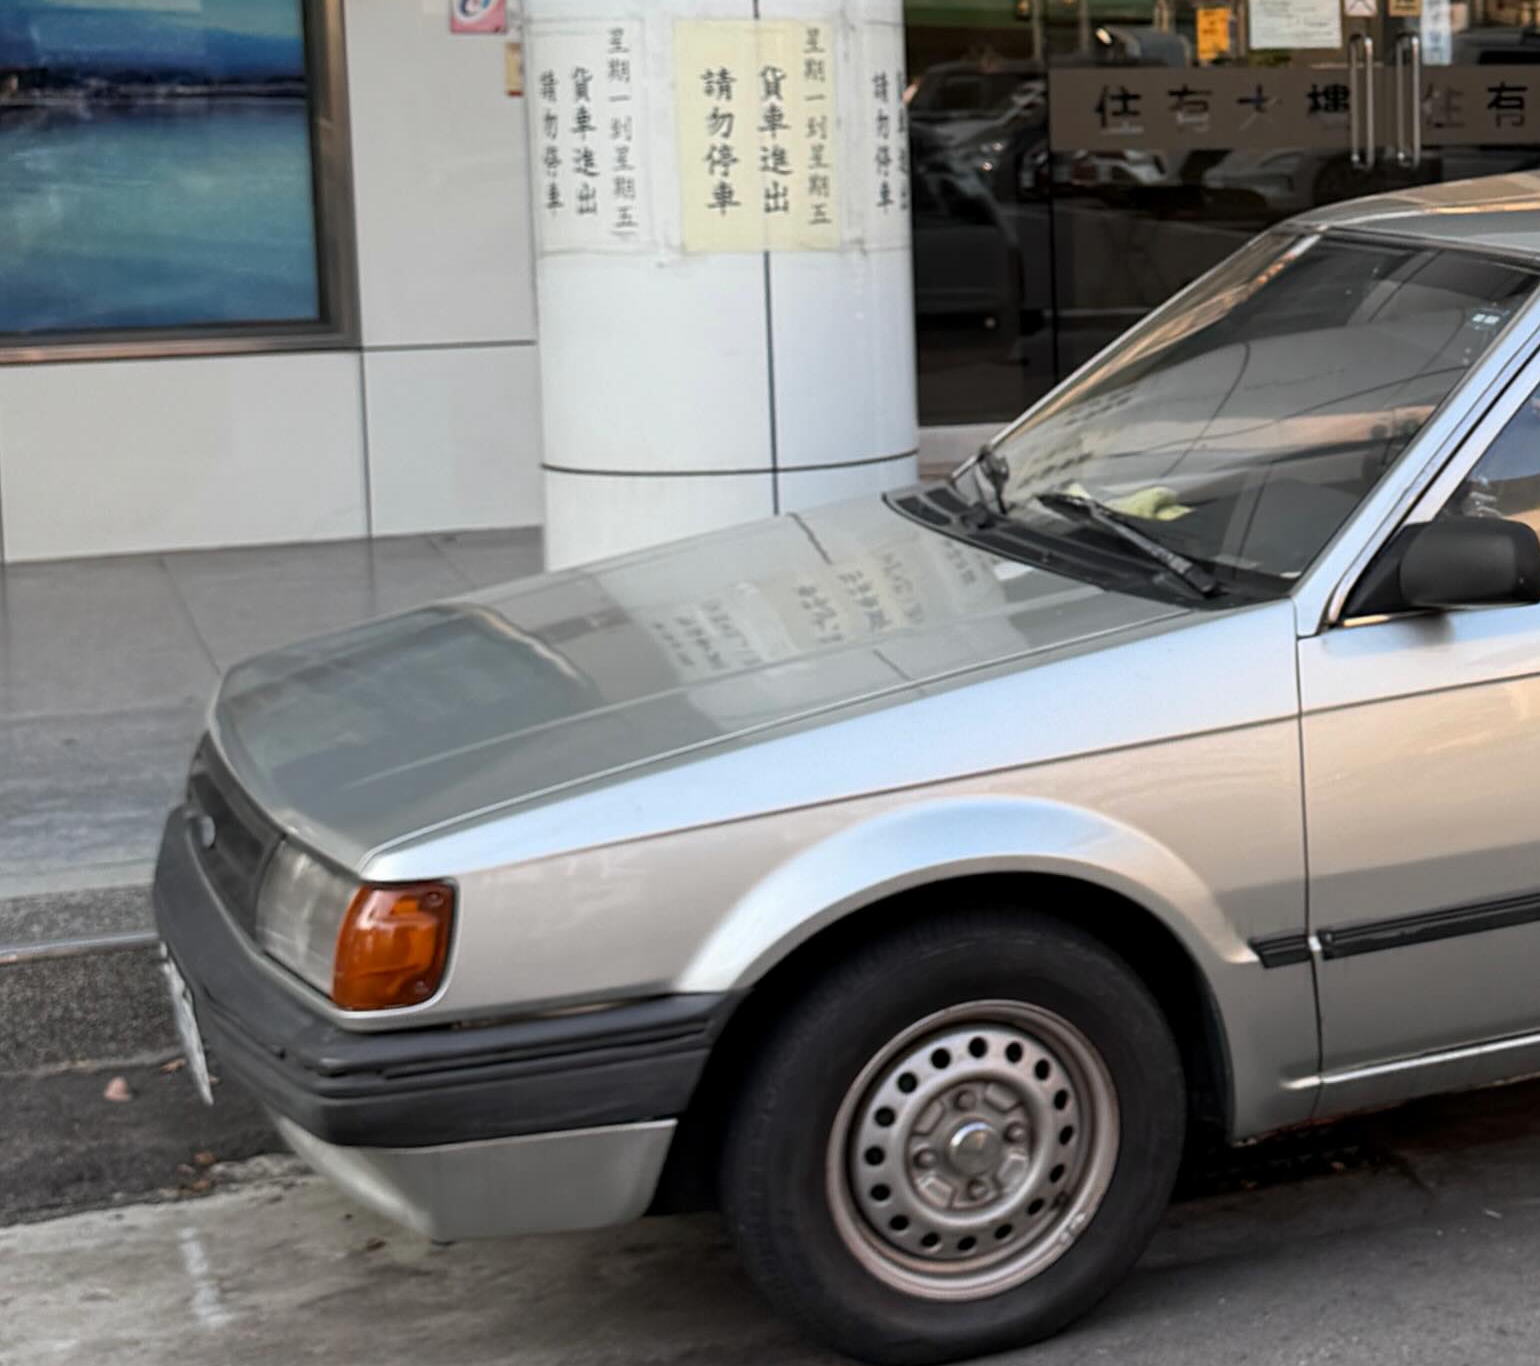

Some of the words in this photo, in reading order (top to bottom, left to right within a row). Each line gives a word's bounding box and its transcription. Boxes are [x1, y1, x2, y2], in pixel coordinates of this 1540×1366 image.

[570, 66, 600, 215] 貨車進出
[700, 66, 741, 216] 請勿停車
[757, 66, 793, 214] 貨車進出
[803, 27, 832, 225] 星期一到星期五
